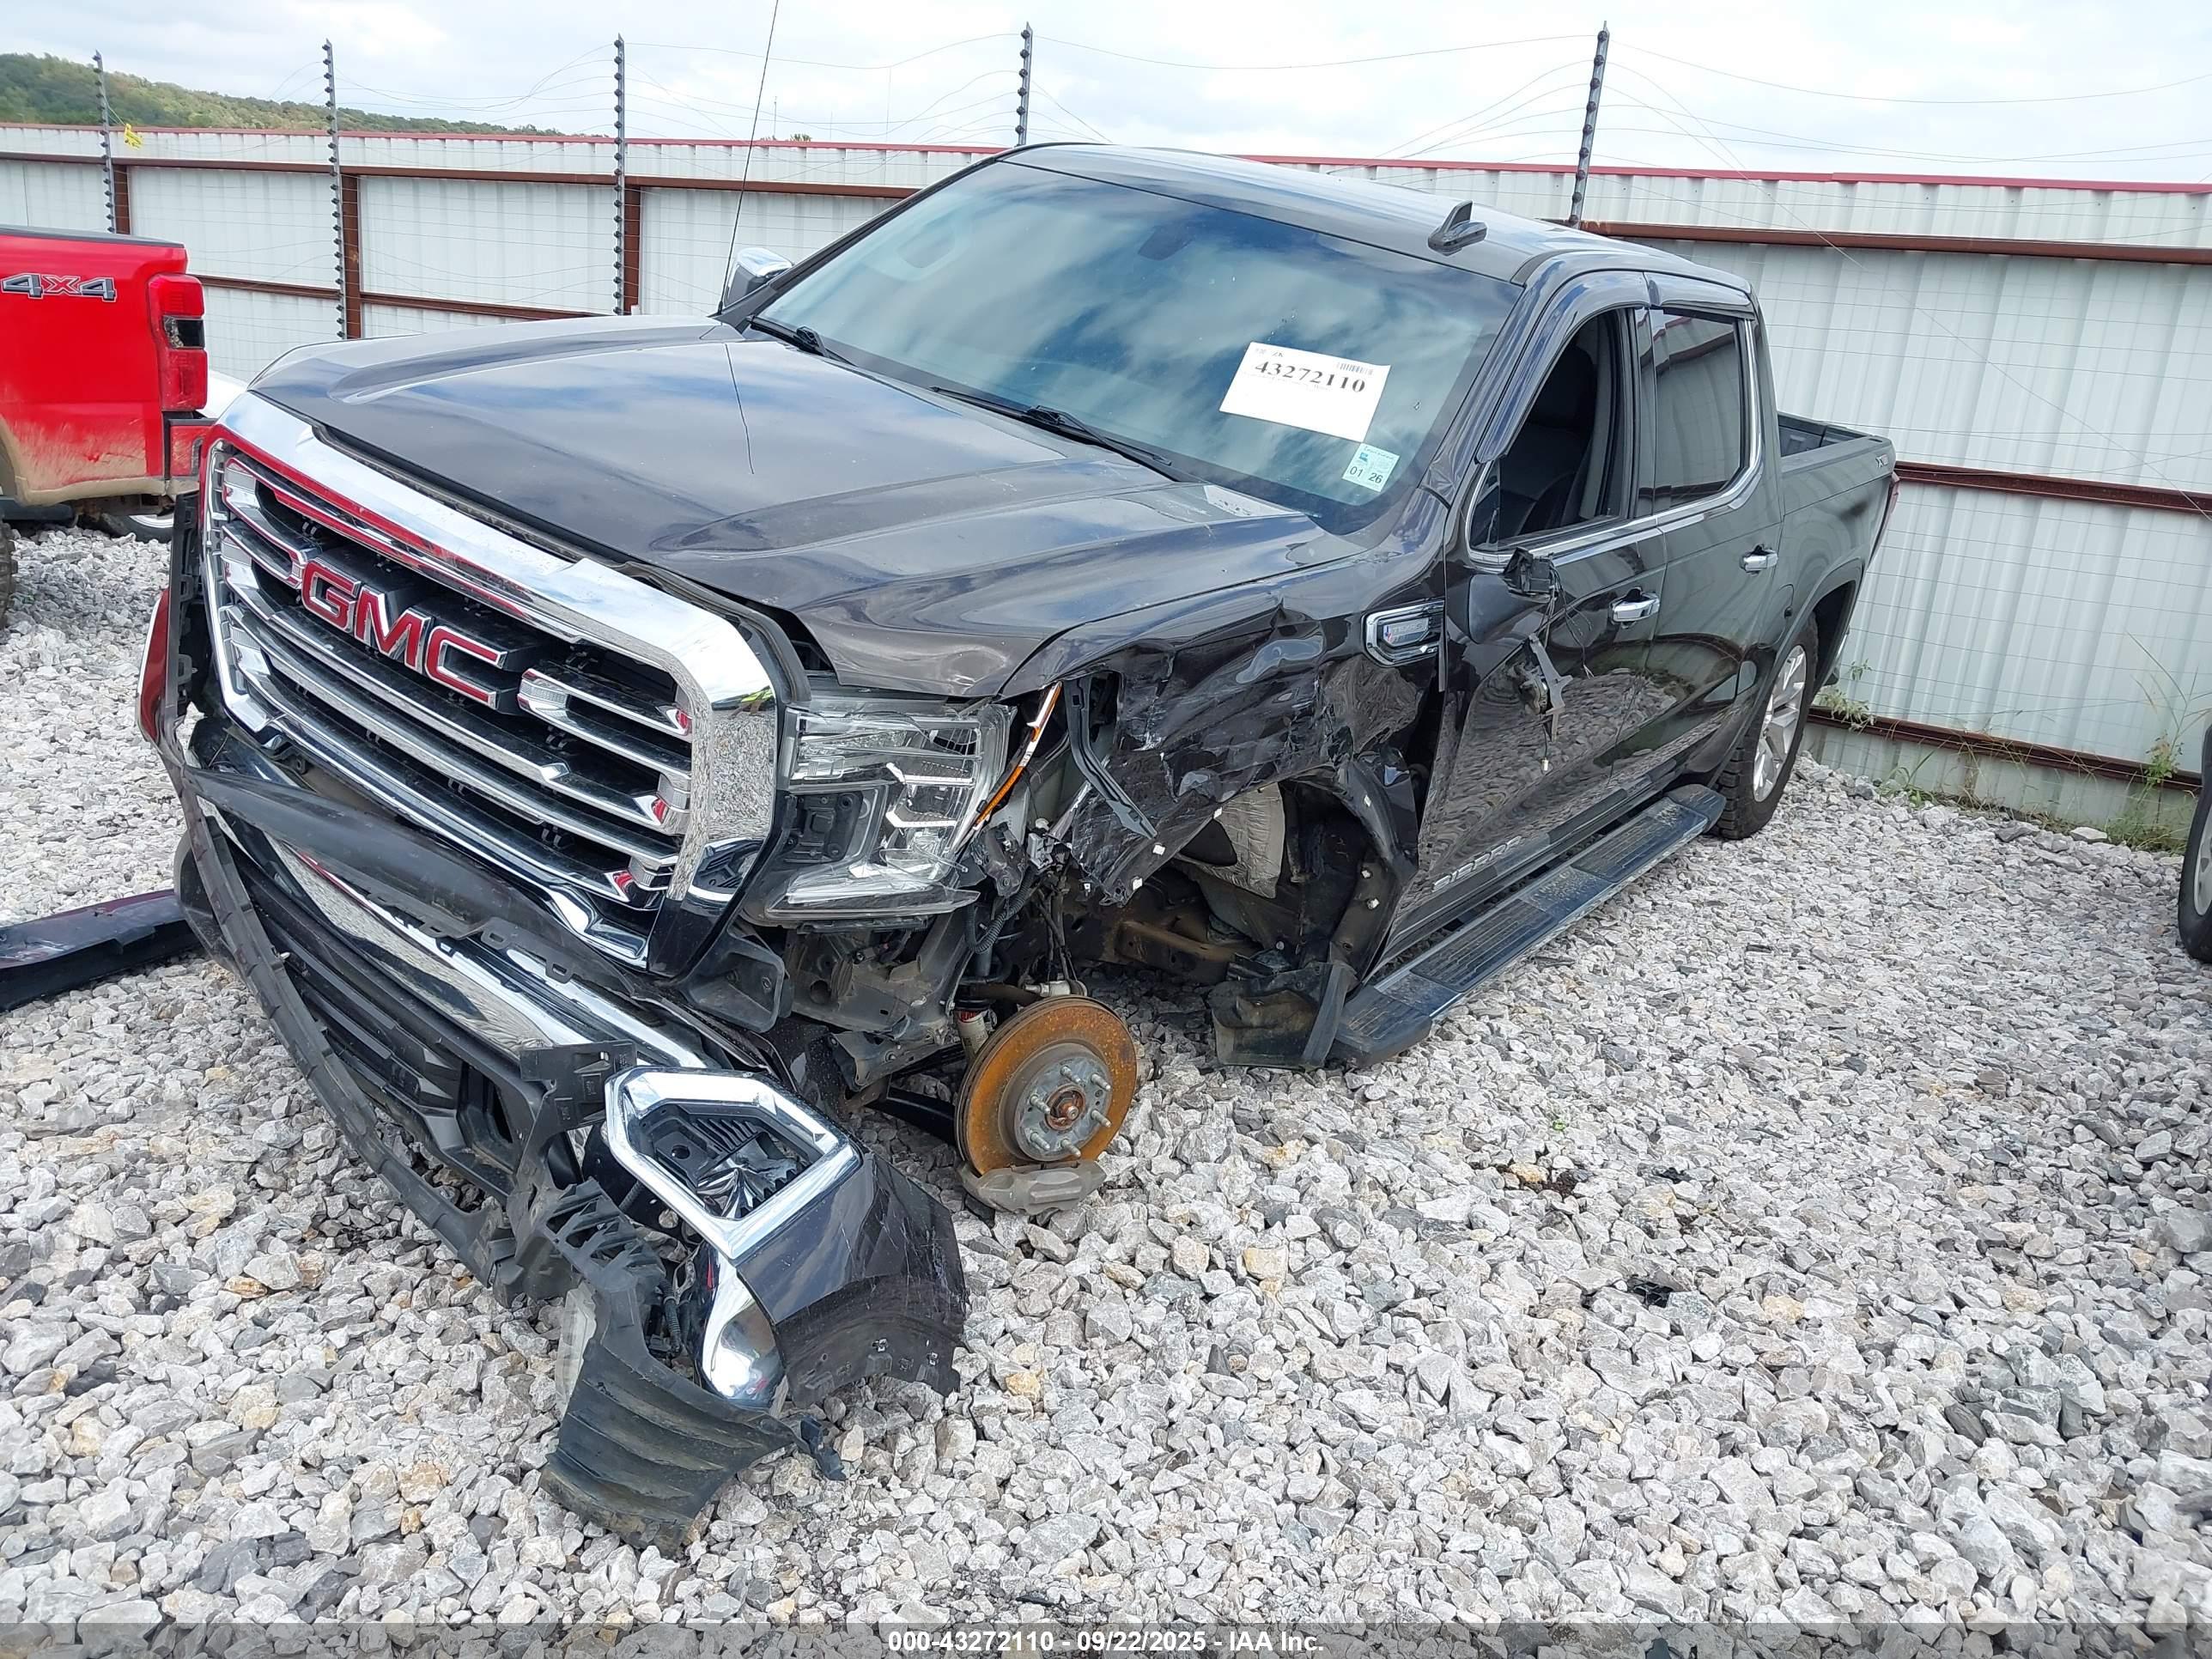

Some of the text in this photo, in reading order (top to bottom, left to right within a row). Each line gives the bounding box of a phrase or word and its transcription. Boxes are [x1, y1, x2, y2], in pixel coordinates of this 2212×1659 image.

[1255, 361, 1365, 392] 43272110
[1349, 465, 1383, 483] 01 26
[301, 557, 507, 710] GMC
